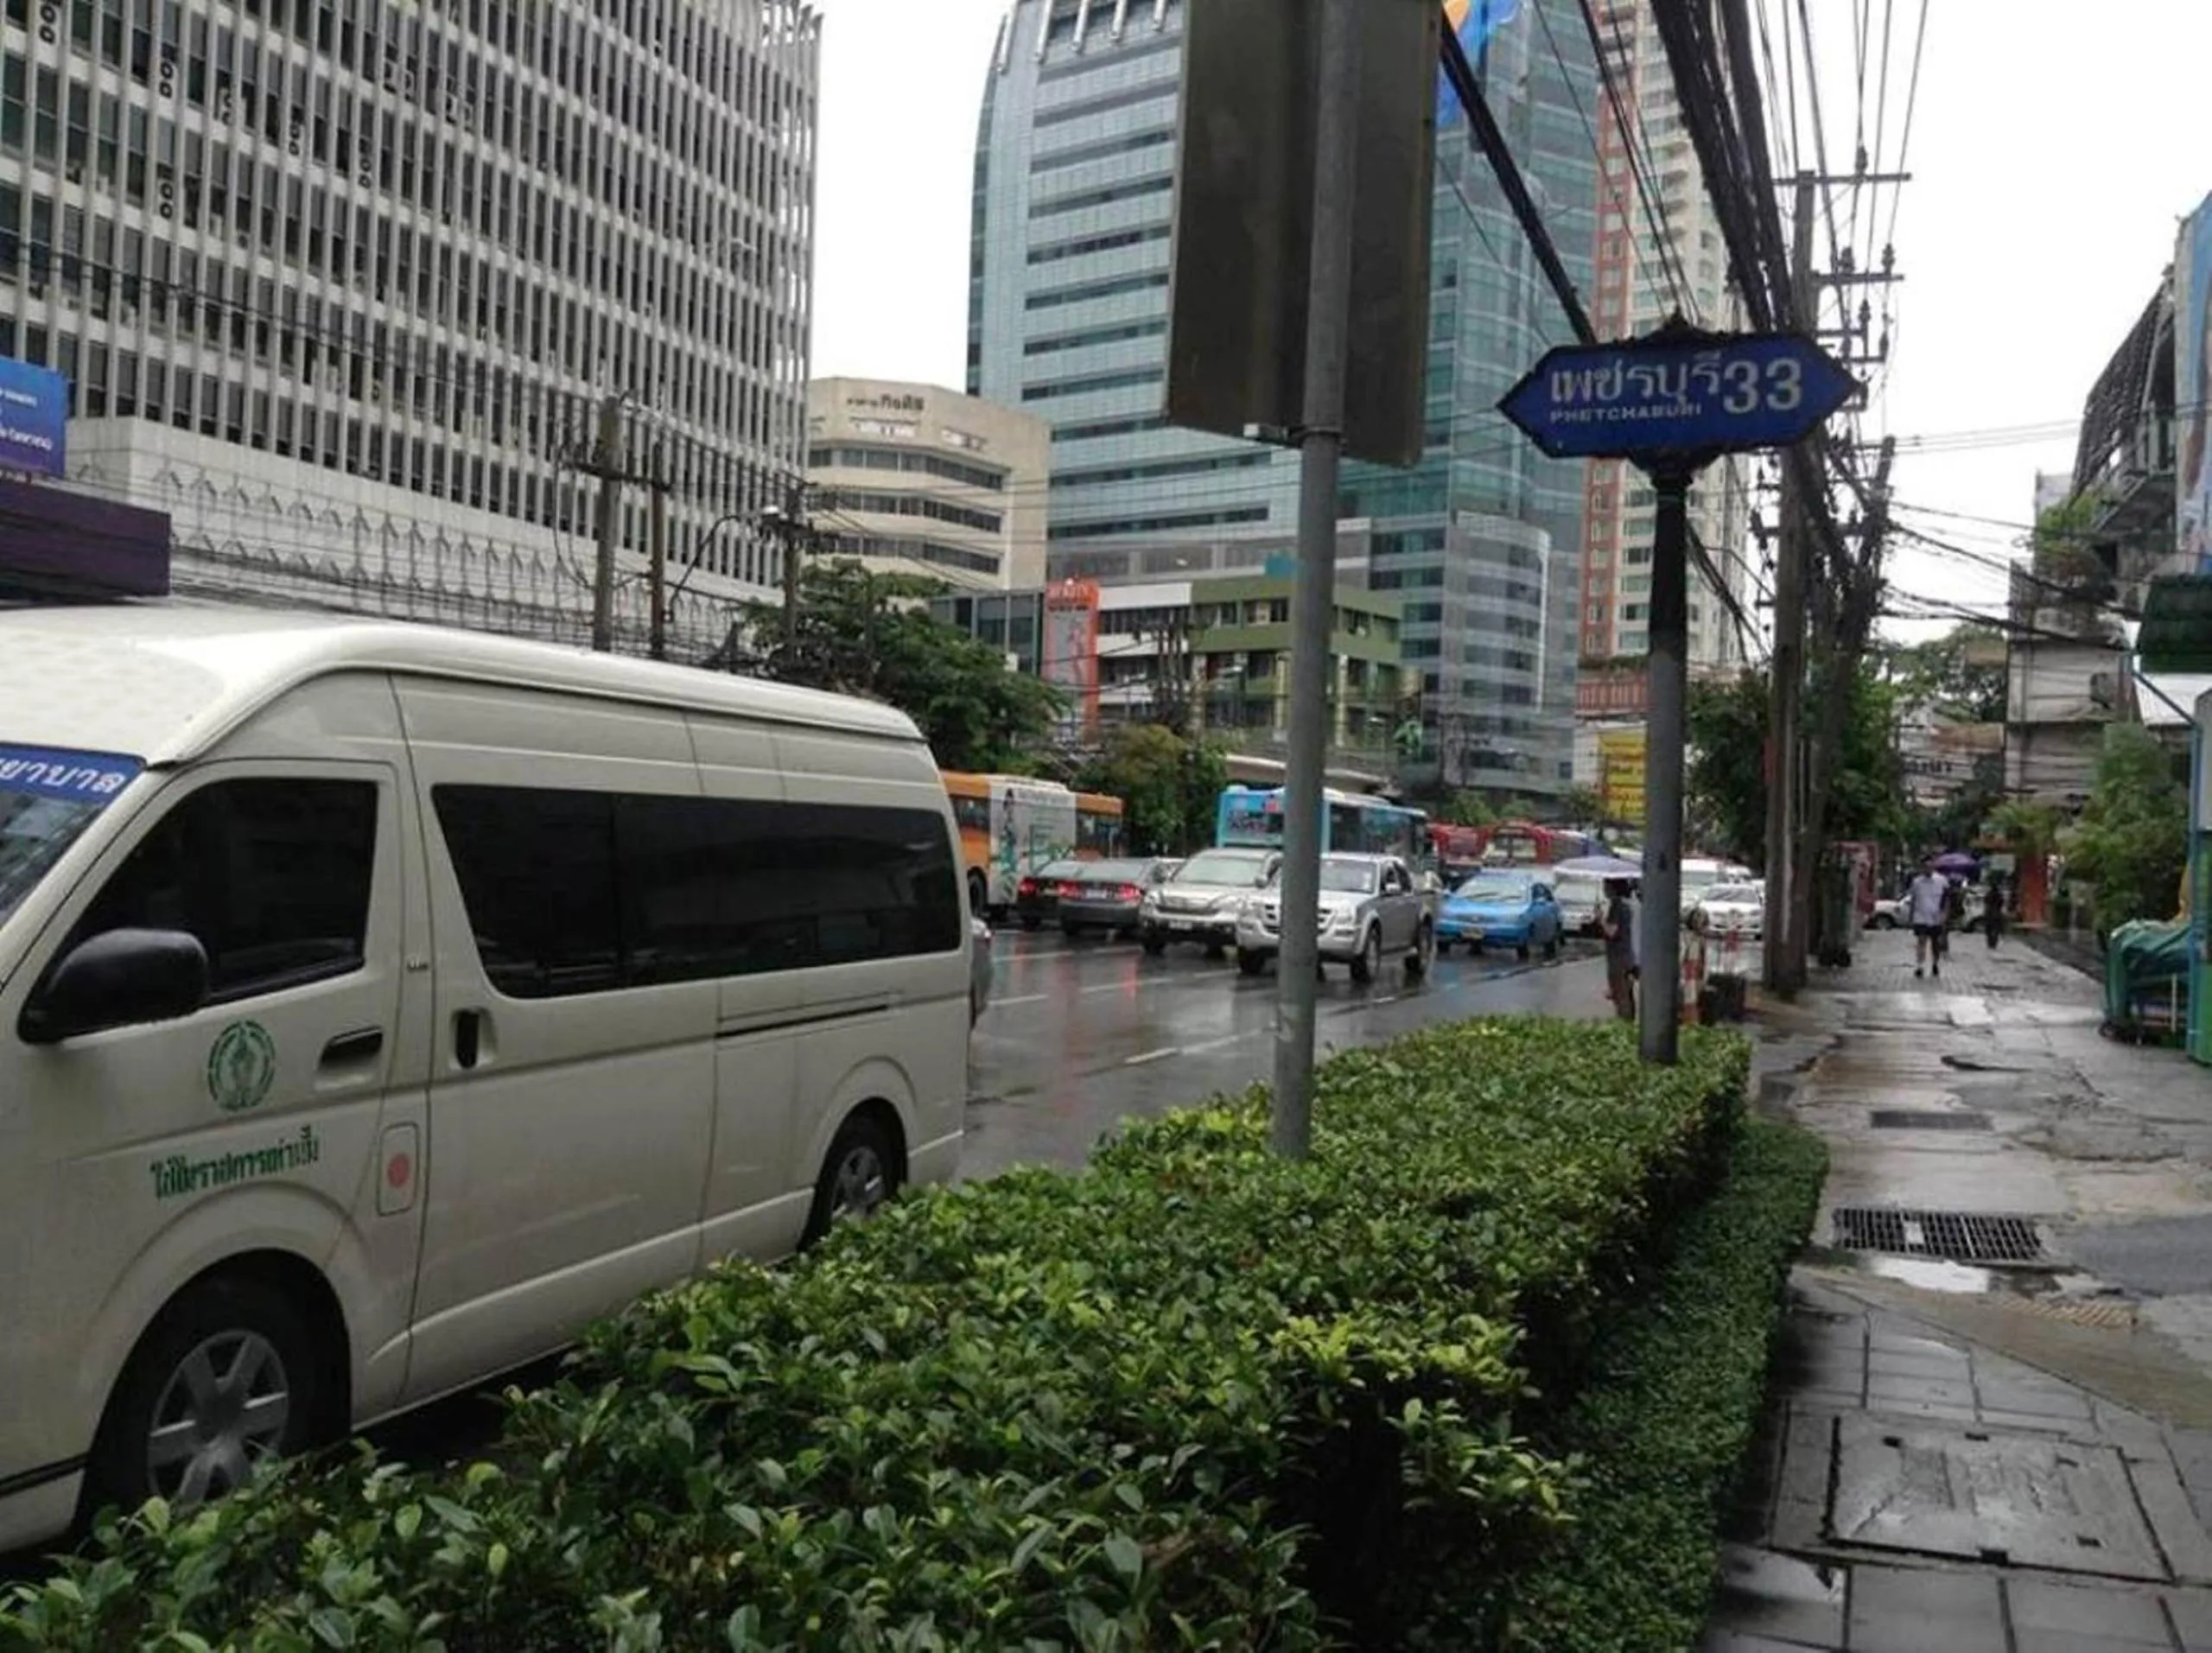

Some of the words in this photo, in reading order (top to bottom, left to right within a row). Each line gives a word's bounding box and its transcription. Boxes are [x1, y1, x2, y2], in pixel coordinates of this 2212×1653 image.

[1549, 350, 1722, 404] เพชรบุรี
[1722, 357, 1802, 414] 33
[1549, 404, 1702, 423] PHETCHABURI
[0, 758, 126, 794] ยาบาล
